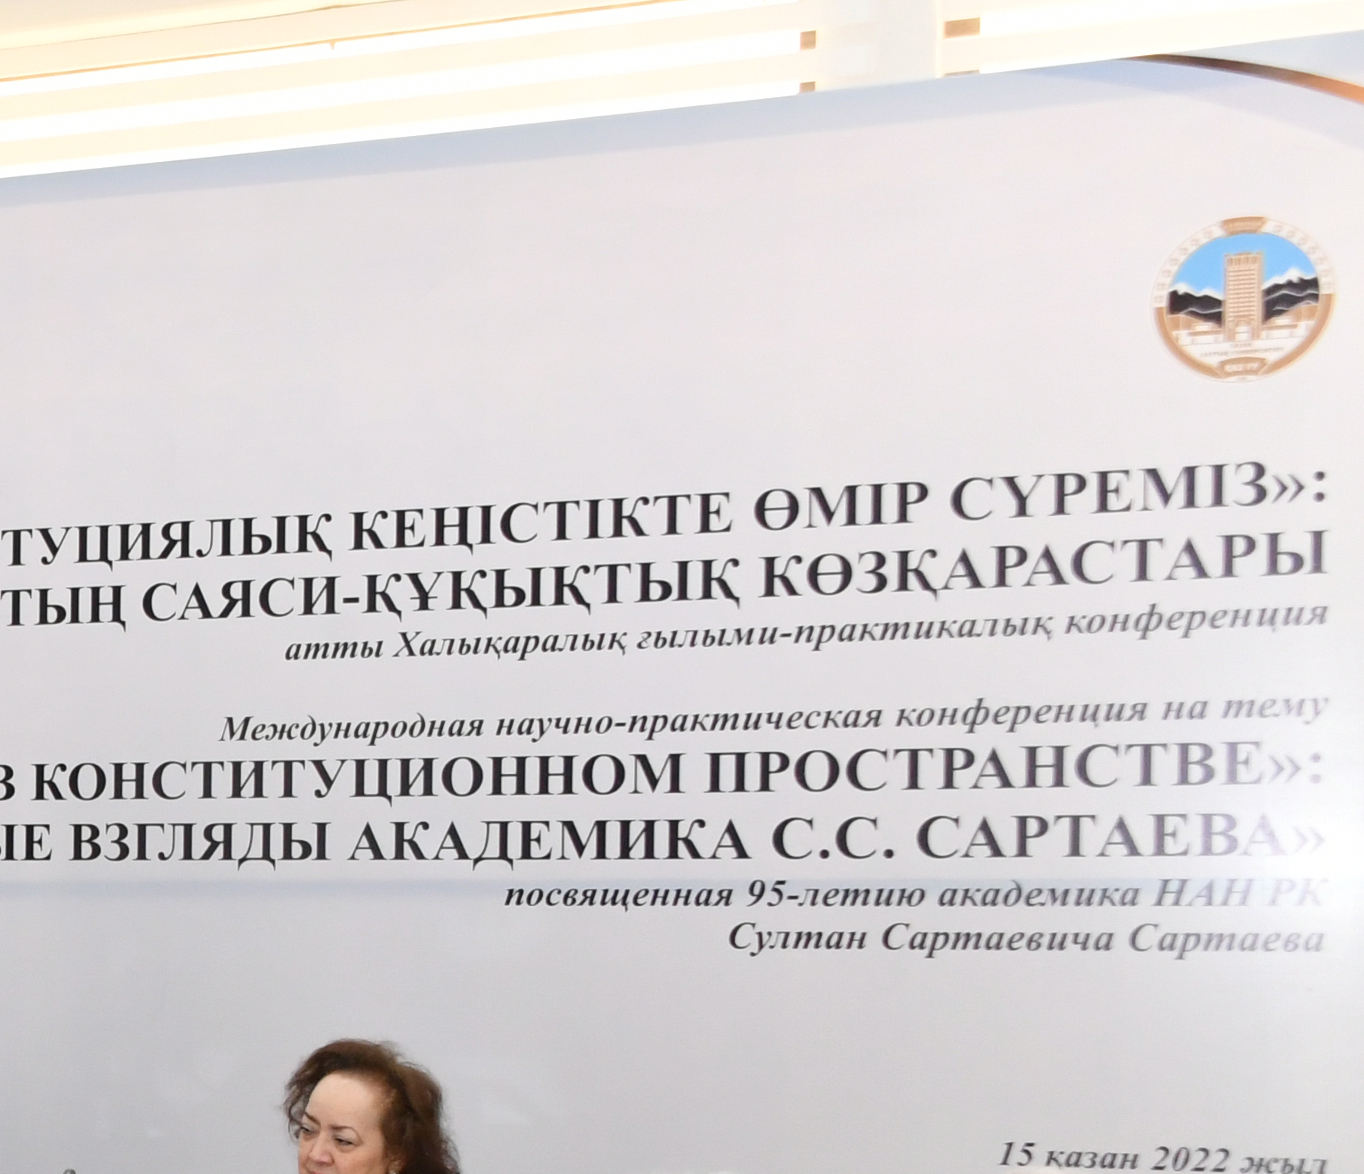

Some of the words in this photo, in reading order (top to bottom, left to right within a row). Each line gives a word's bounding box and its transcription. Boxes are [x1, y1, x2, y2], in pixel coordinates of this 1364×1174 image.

[348, 491, 733, 555] КЕҢІСТІКТЕ
[753, 481, 929, 531] ӨМІР
[950, 461, 1326, 521] СҮРЕМІЗ»:
[142, 557, 741, 623] САЯСИ-ҚҰҚЫҚТЫҚ
[758, 529, 1329, 599] КӨЗҚАРАСТАРЫ
[284, 638, 384, 661] атты
[392, 630, 628, 662] Халықаралық
[636, 616, 1054, 652] ғылыми-практикалық
[1064, 602, 1329, 641] конференция
[218, 712, 485, 748] Международная
[495, 709, 883, 744] научно-практическая
[895, 697, 1149, 735] конференция
[1161, 700, 1209, 721] на
[1221, 696, 1330, 726] тему
[30, 752, 686, 808] КОНСТИТУЦИОННОМ
[704, 740, 1323, 794] ПРОСТРАНСТВЕ»:
[68, 821, 332, 871] ВЗГЛЯДЫ
[346, 818, 752, 871] АКАДЕМИКА
[771, 816, 895, 860] С.С.
[916, 812, 1325, 860] САРТАЕВА»
[504, 887, 734, 913] посвященная
[746, 879, 927, 908] 95-летию
[937, 879, 1142, 908] академика
[1152, 878, 1256, 908] НАН
[728, 921, 868, 958] Султан
[881, 922, 1115, 959] Сартаевича
[1128, 922, 1325, 961] Сартаева
[999, 1140, 1036, 1167] 15
[1150, 1145, 1231, 1173] 2022
